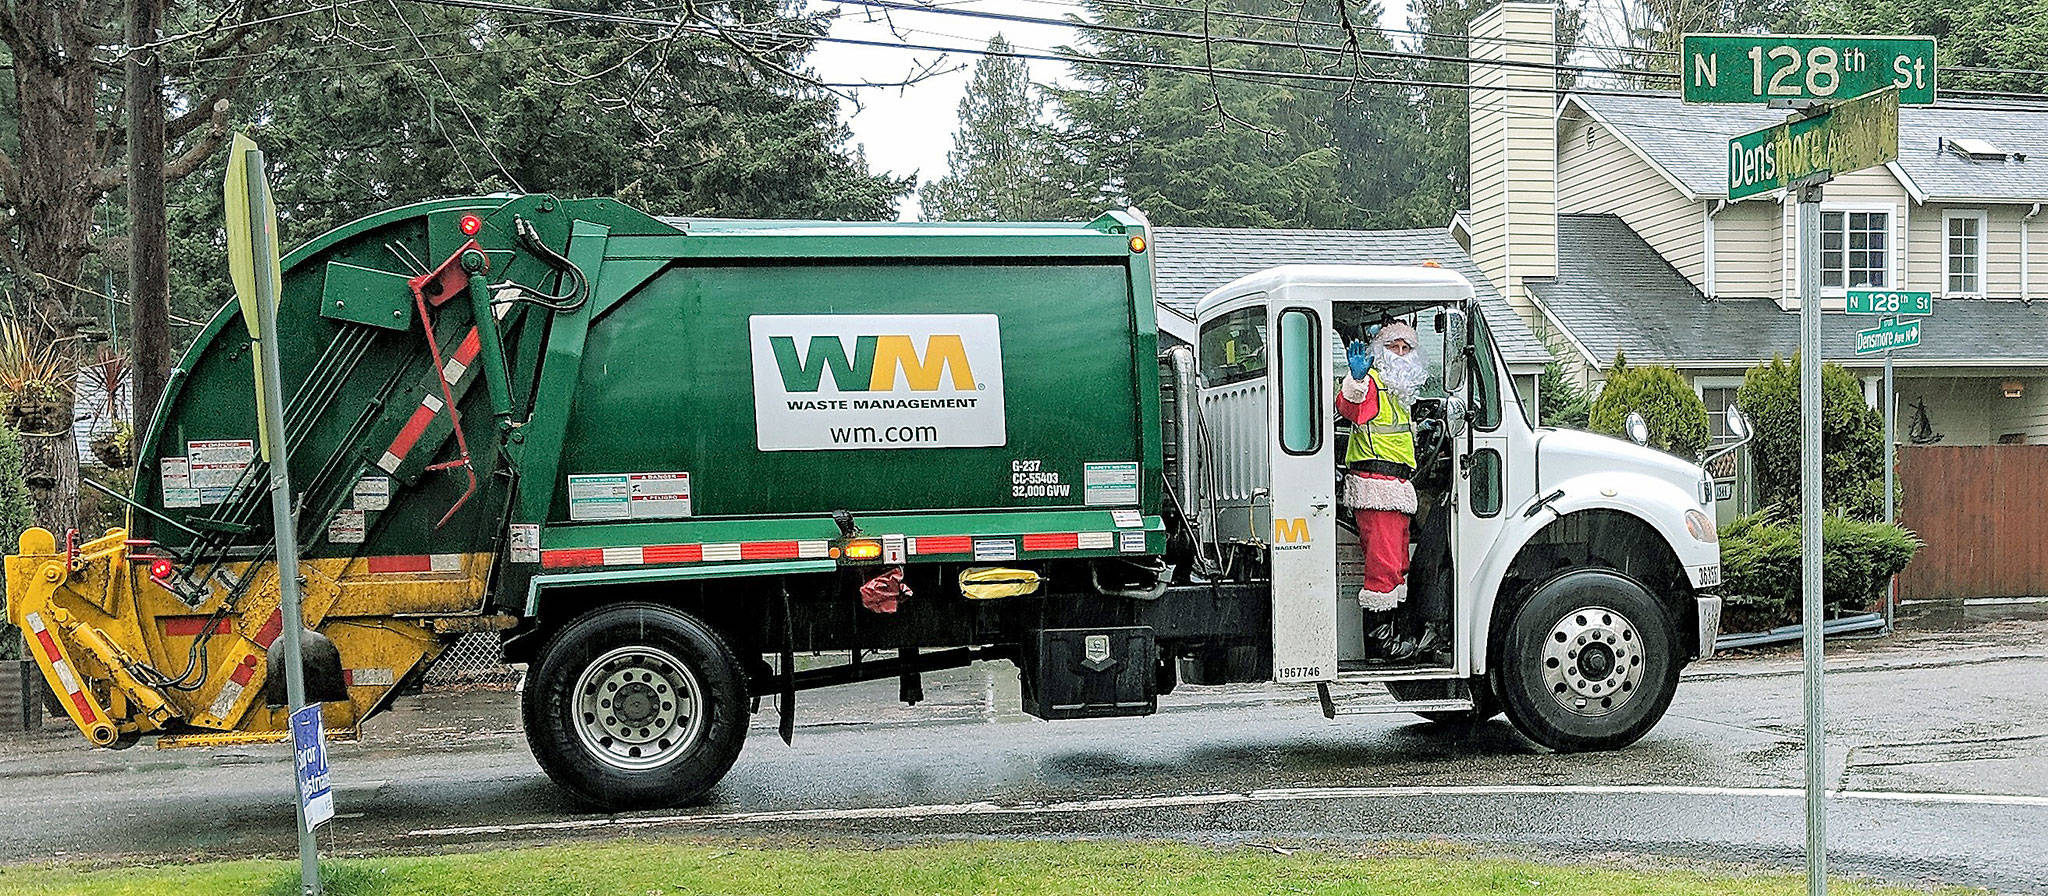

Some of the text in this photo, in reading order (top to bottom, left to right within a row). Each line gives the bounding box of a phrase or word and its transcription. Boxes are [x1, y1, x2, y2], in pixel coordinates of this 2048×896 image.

[1694, 45, 1926, 97] N 128th St
[1731, 128, 1822, 189] Densmore
[1826, 129, 1852, 166] Ave
[1849, 293, 1929, 312] N 128th St
[1857, 328, 1912, 351] Densmore Ave N
[768, 334, 978, 393] WM
[786, 398, 978, 411] WASTE MANAGEMENT
[830, 425, 938, 444] wm.com
[1012, 460, 1041, 472] G-237
[1012, 472, 1059, 484] CC-55403
[1012, 484, 1070, 498] 32,000 GVW
[1279, 666, 1320, 678] 1967746
